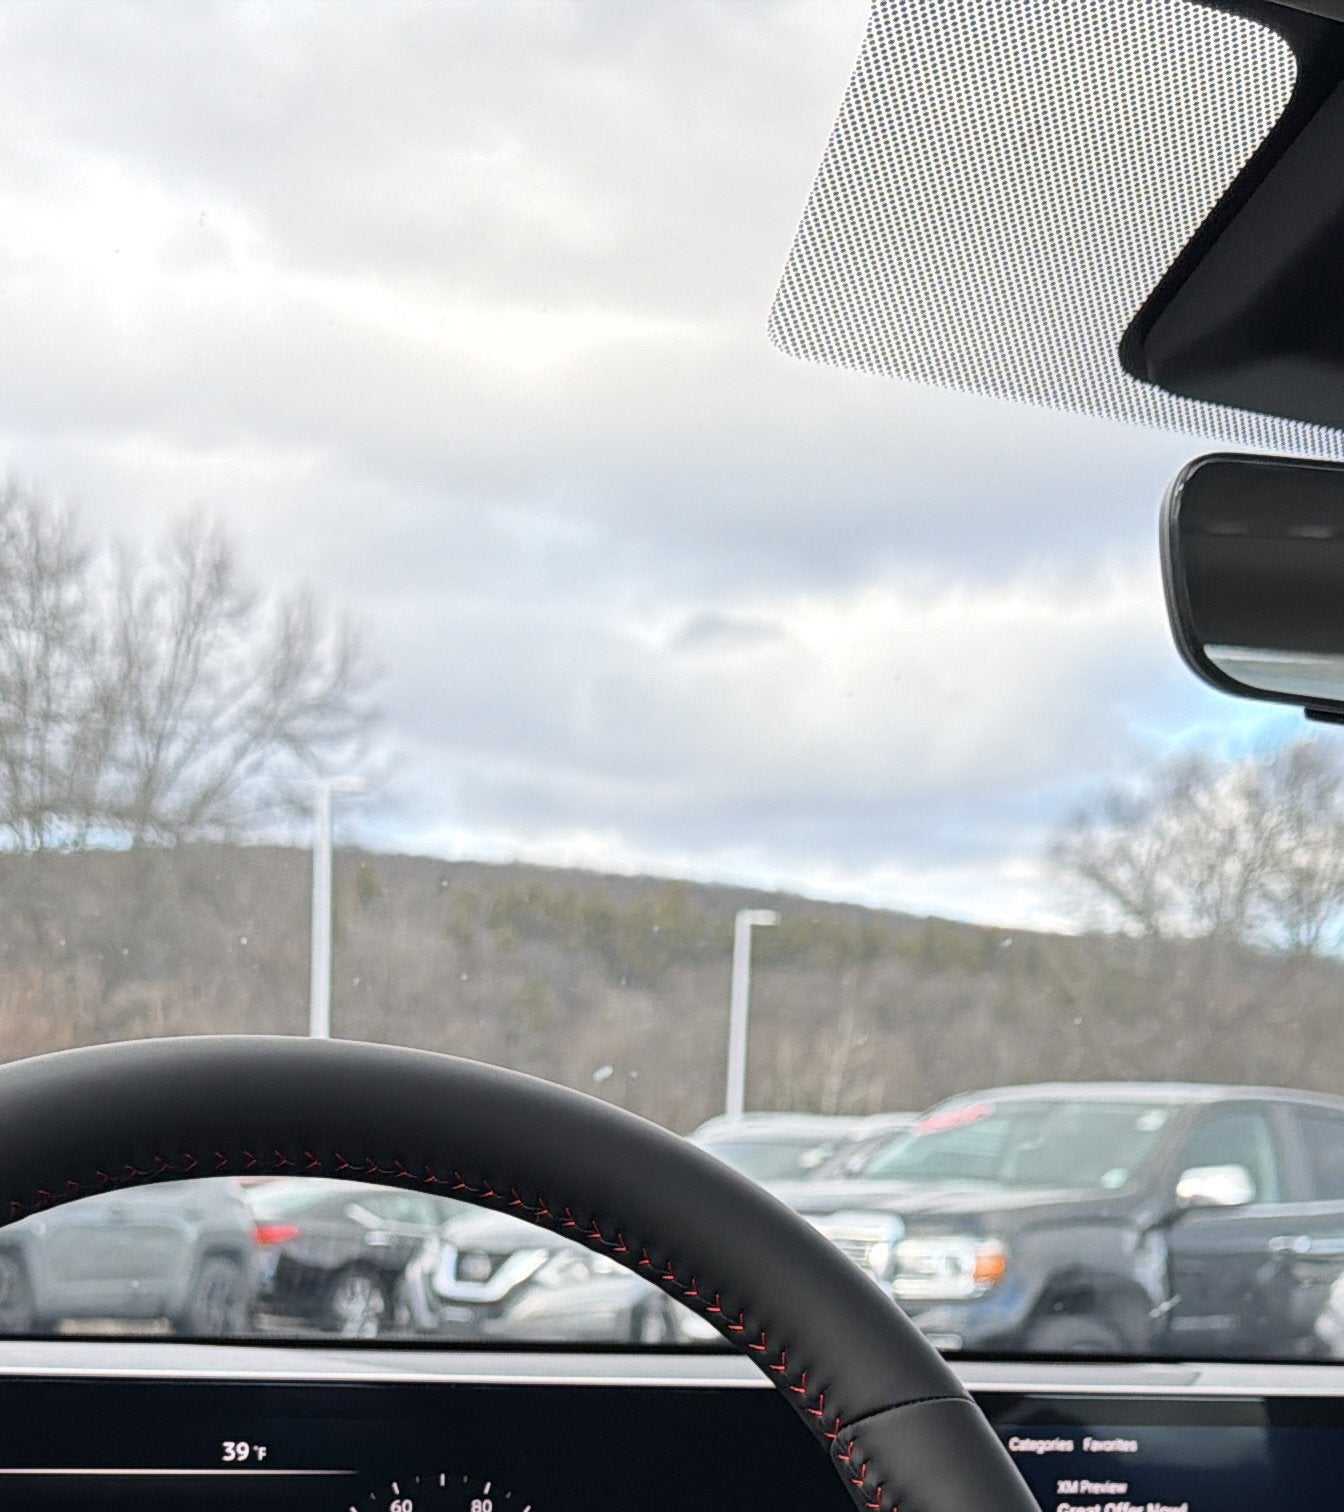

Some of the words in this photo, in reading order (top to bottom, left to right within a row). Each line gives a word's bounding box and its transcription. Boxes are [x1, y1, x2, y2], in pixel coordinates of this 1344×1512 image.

[1008, 1436, 1075, 1455] Categories
[1082, 1436, 1138, 1453] Favorites
[1080, 1480, 1129, 1495] Preview
